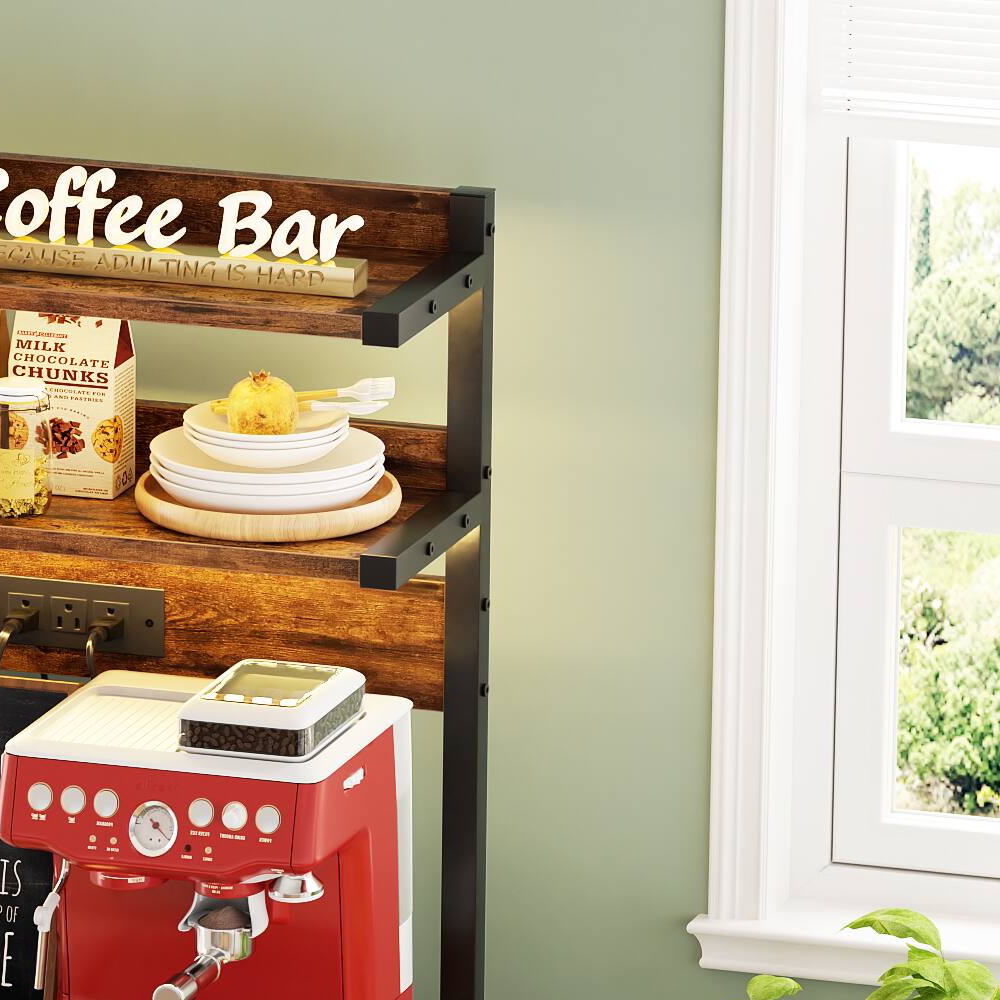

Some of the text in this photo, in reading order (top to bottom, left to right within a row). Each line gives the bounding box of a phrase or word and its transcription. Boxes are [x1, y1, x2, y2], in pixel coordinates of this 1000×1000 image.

[217, 190, 365, 263] Bar
[94, 251, 217, 284] ADULTING
[225, 262, 248, 282] IS
[256, 266, 326, 288] HARD
[16, 339, 66, 353] MILK
[13, 352, 110, 369] CHOCOLATE
[12, 365, 109, 384] CHUNKS
[49, 388, 91, 396] CHOCOLATE
[6, 903, 20, 924] OF
